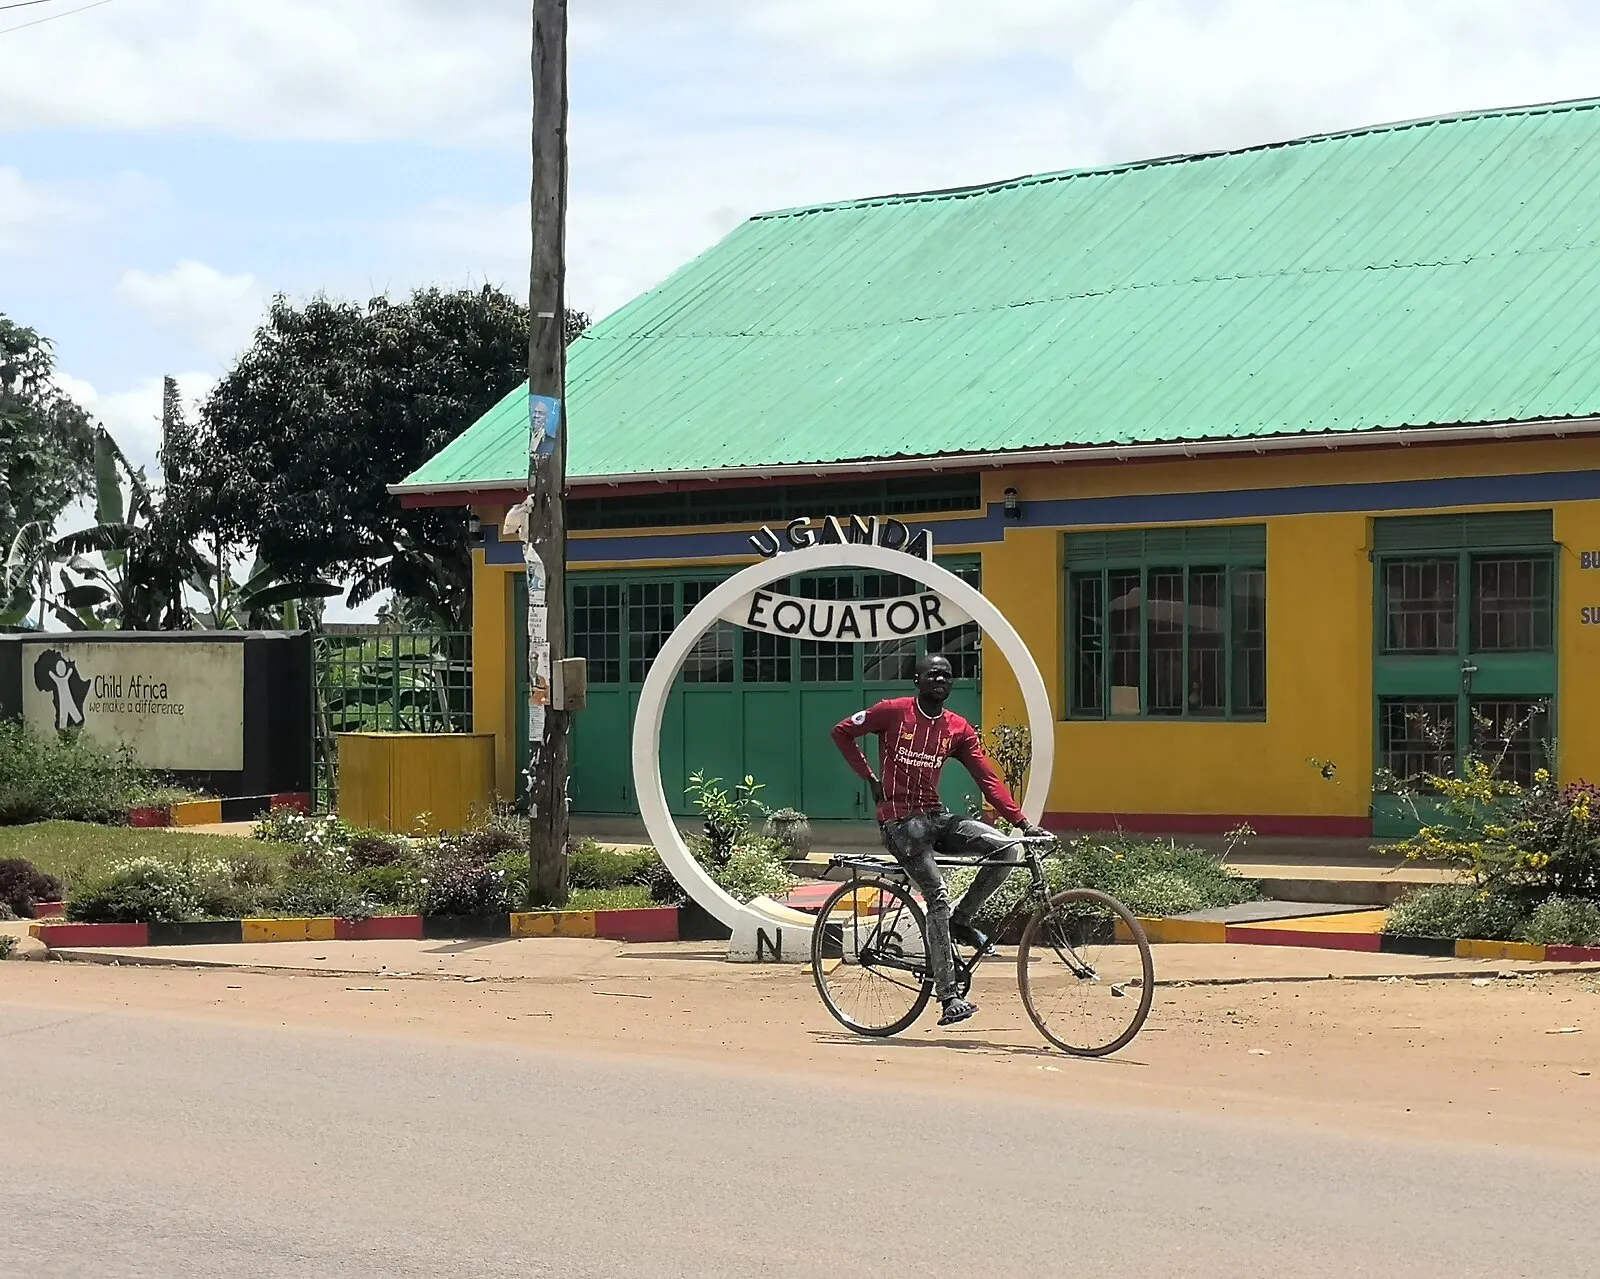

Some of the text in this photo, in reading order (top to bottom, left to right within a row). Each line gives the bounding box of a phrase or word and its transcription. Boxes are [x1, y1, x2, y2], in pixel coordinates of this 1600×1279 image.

[747, 514, 933, 562] UGANDA
[747, 591, 947, 640] EQUATOR
[94, 675, 168, 699] Child Africa
[89, 700, 185, 716] we make a difference
[895, 753, 934, 769] Chartered
[898, 746, 936, 763] Standard
[757, 927, 782, 961] N
